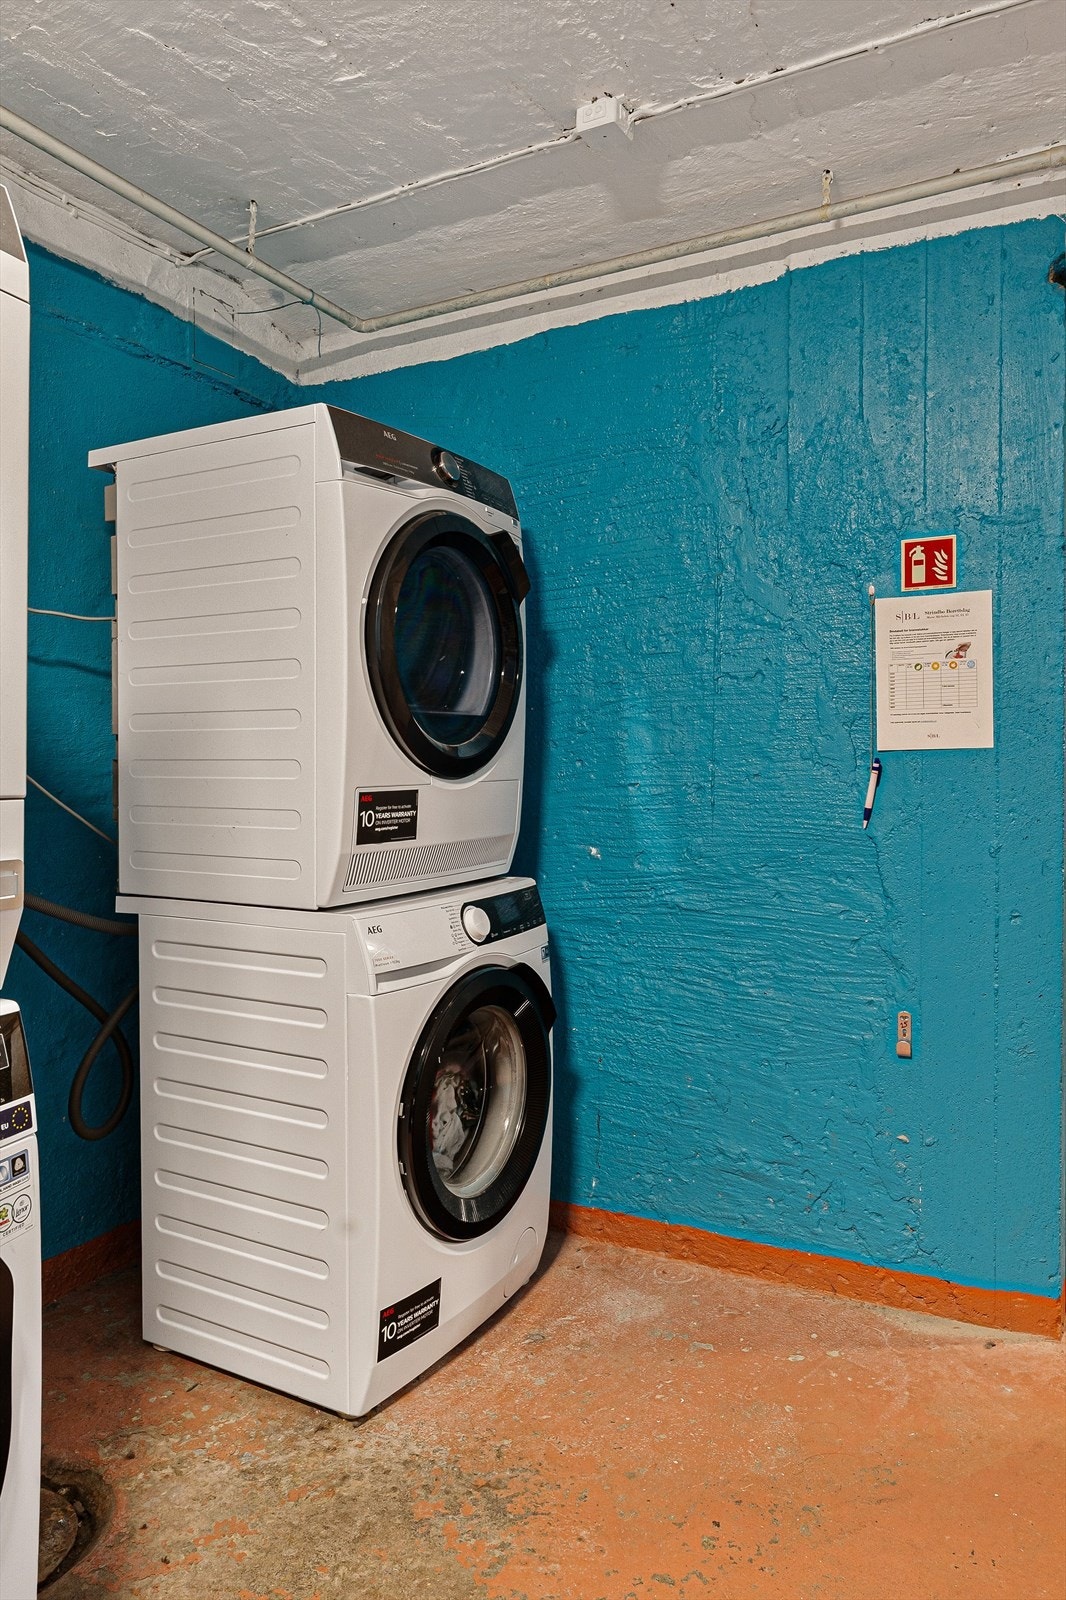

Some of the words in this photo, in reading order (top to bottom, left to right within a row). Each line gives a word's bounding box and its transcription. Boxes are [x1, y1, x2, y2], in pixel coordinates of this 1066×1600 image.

[383, 430, 397, 441] AEG
[359, 810, 375, 828] 10
[367, 925, 383, 935] AEG
[1, 1122, 9, 1131] EU
[2, 1222, 25, 1237] CERTIFIED
[382, 1307, 395, 1318] AEG
[397, 1313, 414, 1328] YEARS
[413, 1298, 440, 1319] WARRANTY
[403, 1317, 421, 1331] INVERTER
[420, 1309, 434, 1320] MOTOR
[381, 1321, 397, 1343] 10
